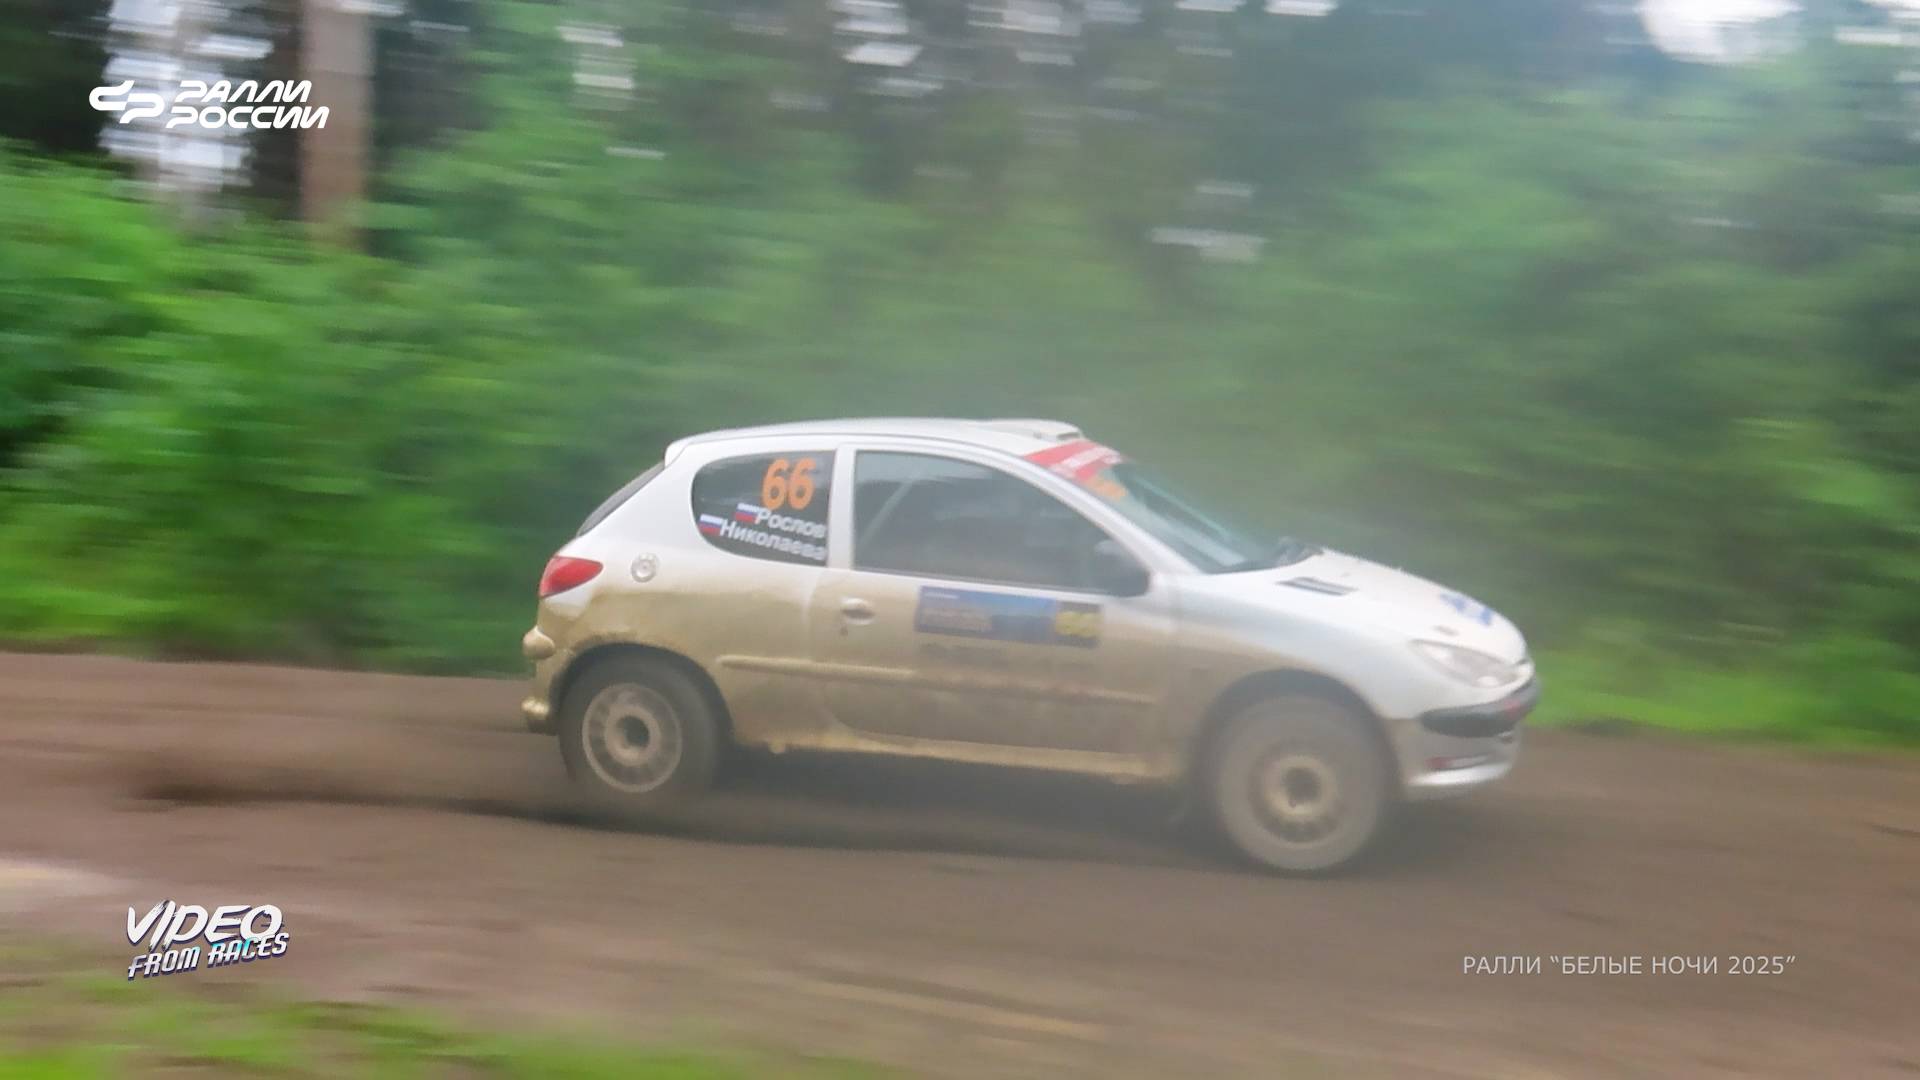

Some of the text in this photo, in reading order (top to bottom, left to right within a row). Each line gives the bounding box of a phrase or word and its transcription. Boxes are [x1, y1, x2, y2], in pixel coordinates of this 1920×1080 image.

[762, 458, 817, 510] 66
[720, 519, 827, 561] Николаева
[755, 507, 827, 538] Рослов
